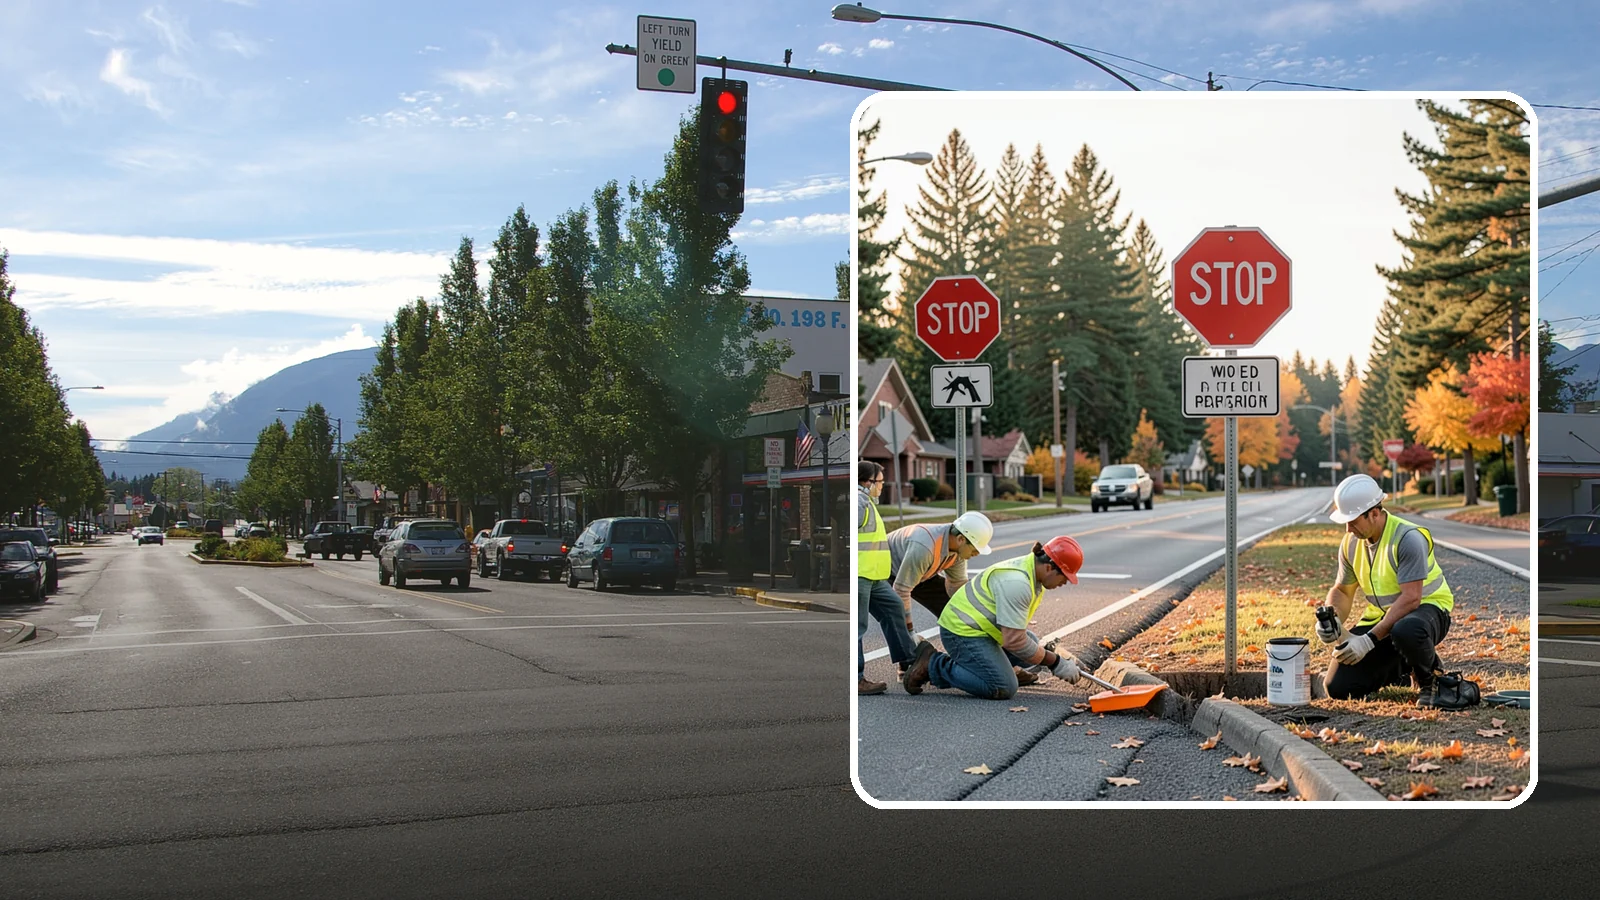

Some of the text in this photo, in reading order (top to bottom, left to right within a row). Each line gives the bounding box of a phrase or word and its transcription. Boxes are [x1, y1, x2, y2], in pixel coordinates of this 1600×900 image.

[642, 23, 690, 36] LEFT TURN
[652, 38, 682, 52] YIELD
[644, 53, 689, 66] ON GREEN
[1190, 261, 1277, 306] STOP
[763, 308, 786, 327] O.
[791, 309, 826, 328] 198
[831, 311, 847, 329] F.
[927, 301, 990, 335] STOP
